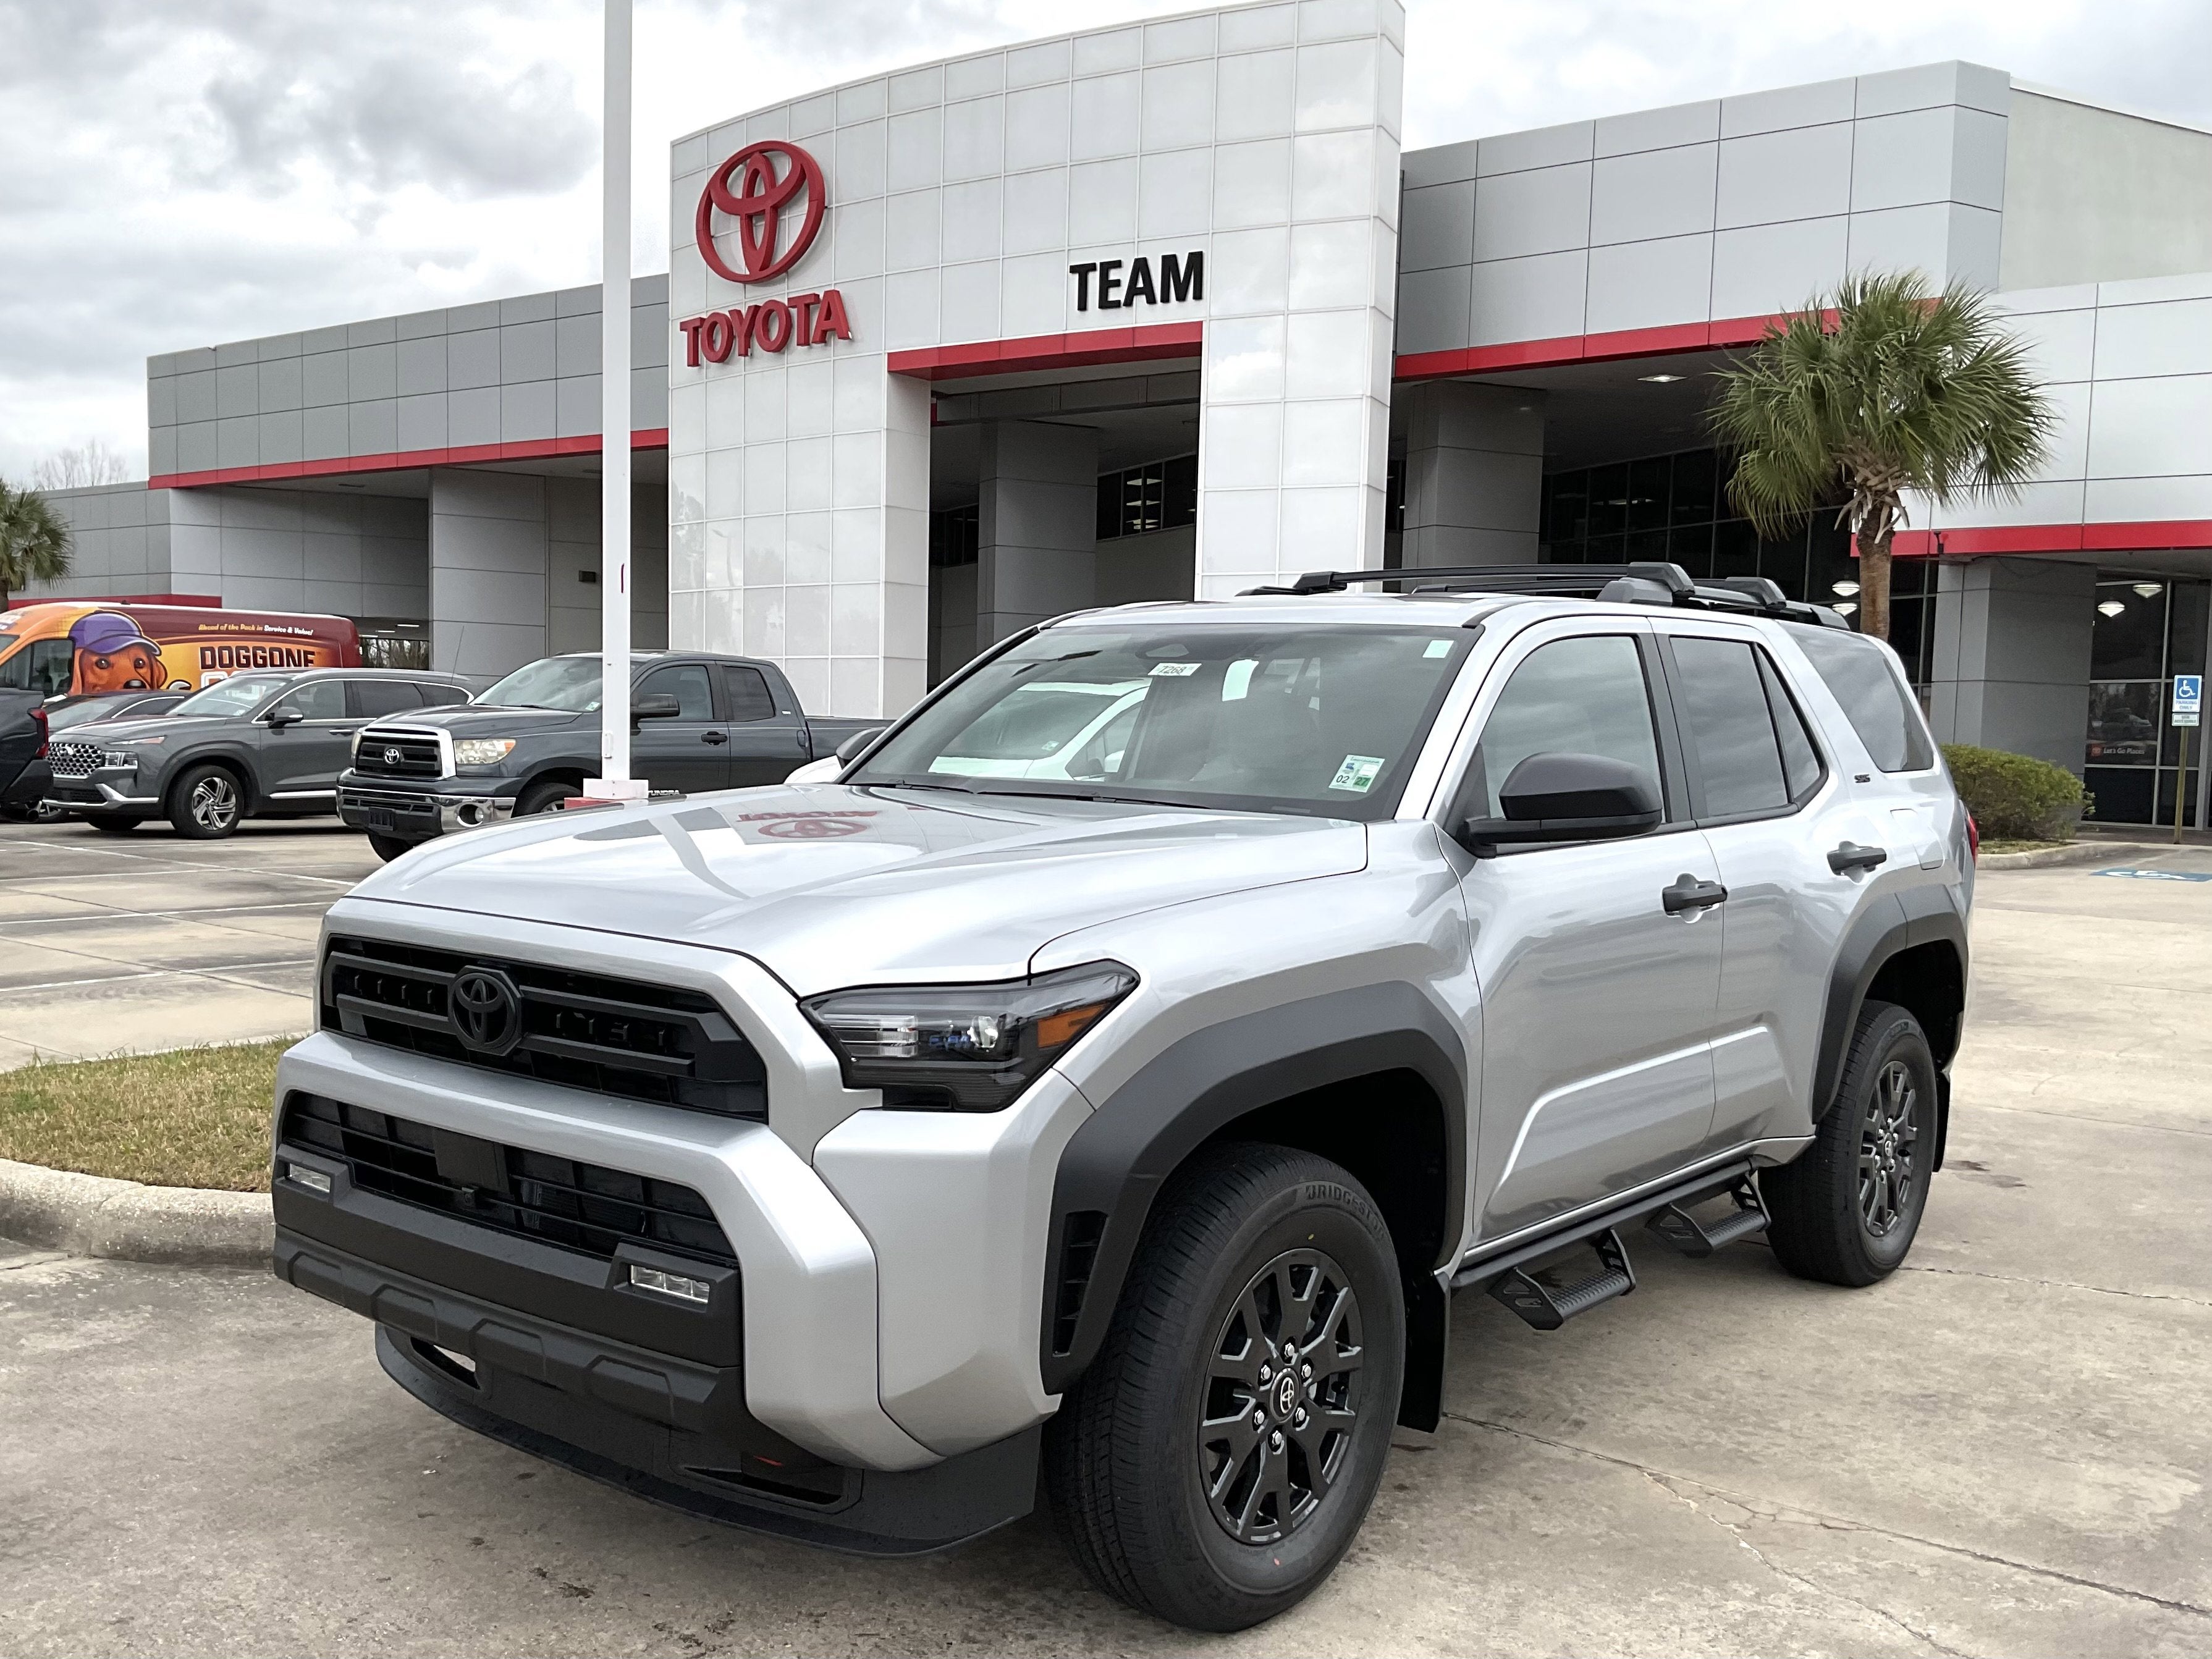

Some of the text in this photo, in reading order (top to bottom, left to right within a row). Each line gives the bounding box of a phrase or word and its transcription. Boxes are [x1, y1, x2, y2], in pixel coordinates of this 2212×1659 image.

[1070, 251, 1203, 311] TEAM
[680, 289, 852, 367] TOYOTA
[264, 625, 286, 633] Service
[294, 627, 313, 636] Value!
[200, 646, 315, 670] DOGGONE
[1159, 665, 1187, 675] 7268
[1336, 775, 1370, 786] 02 27
